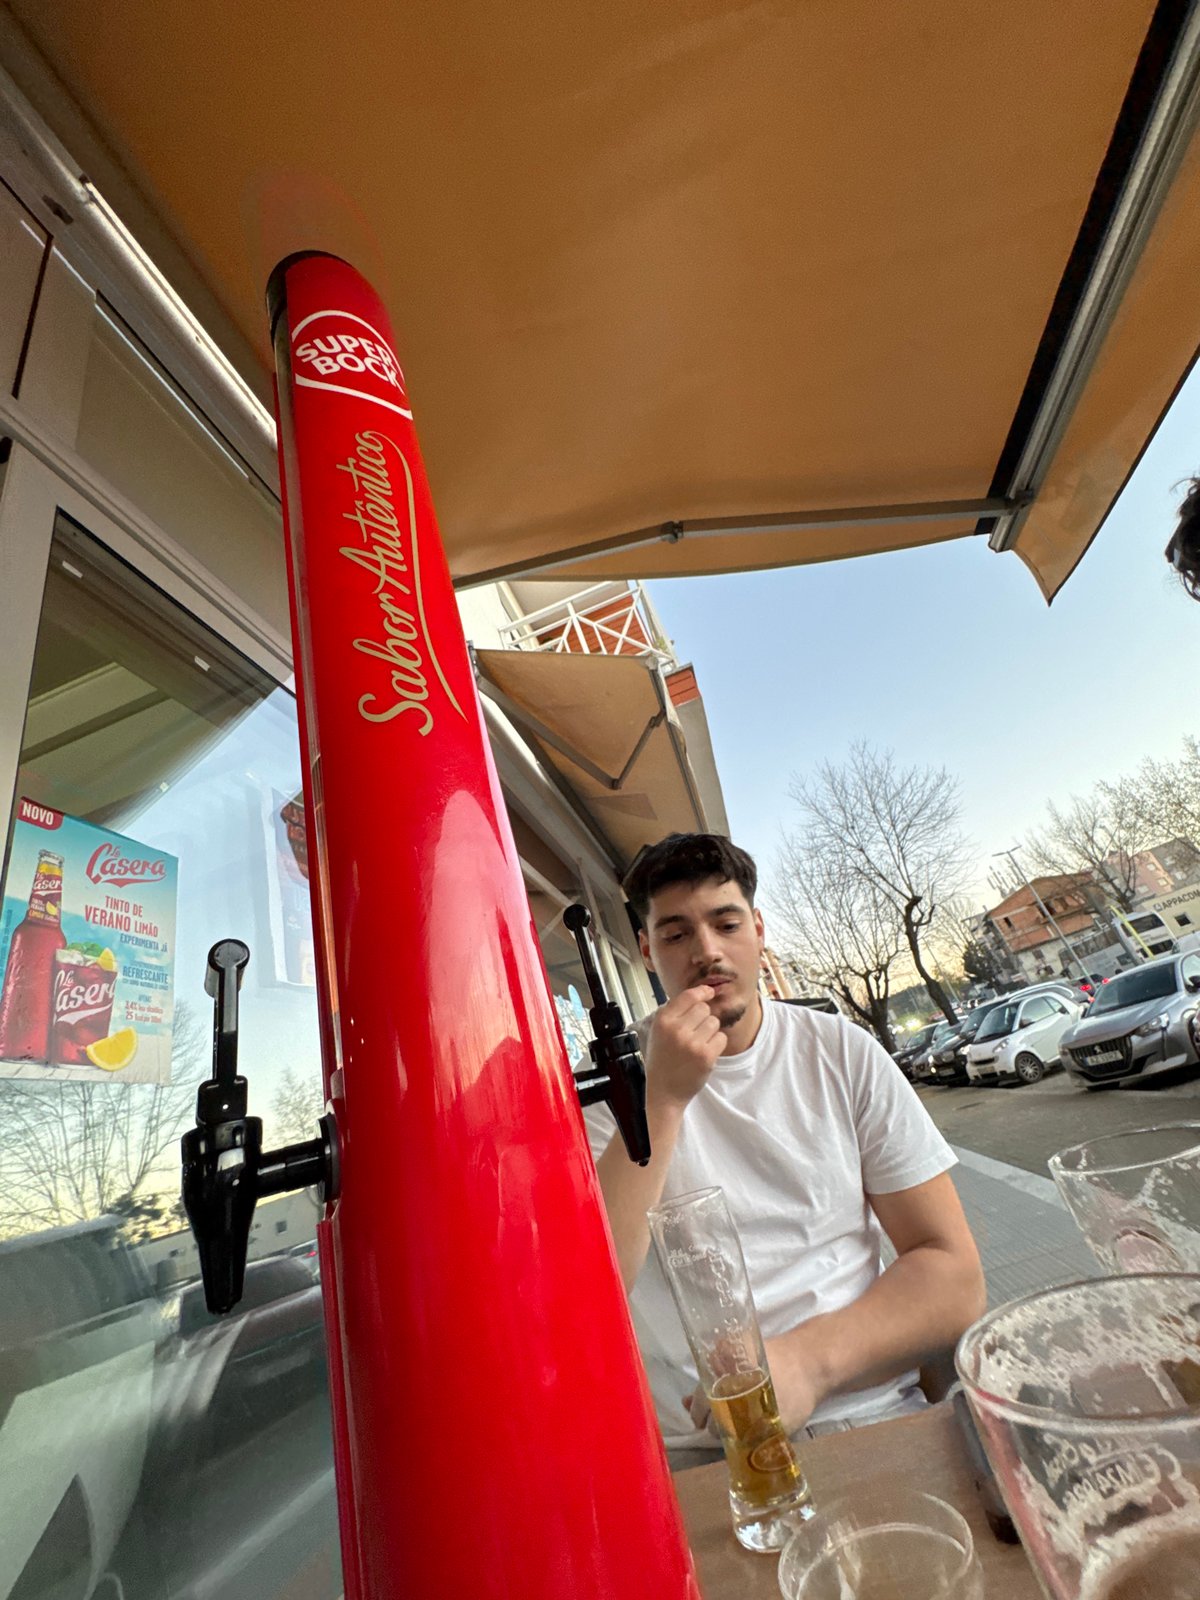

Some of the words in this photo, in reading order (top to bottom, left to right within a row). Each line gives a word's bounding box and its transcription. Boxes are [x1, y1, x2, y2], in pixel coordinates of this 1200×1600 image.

[296, 335, 398, 374] SUPER
[311, 353, 404, 396] BOCK
[336, 430, 411, 594] Autêntico
[352, 592, 434, 737] Sabor
[22, 801, 54, 826] NOVO
[85, 842, 167, 886] Casera
[85, 904, 131, 932] VERANO
[134, 921, 159, 938] LIMÃO
[105, 895, 130, 914] TINTO
[132, 903, 143, 918] DE
[120, 933, 159, 950] EXPERIMENTA
[122, 965, 169, 985] REFRESCANTE
